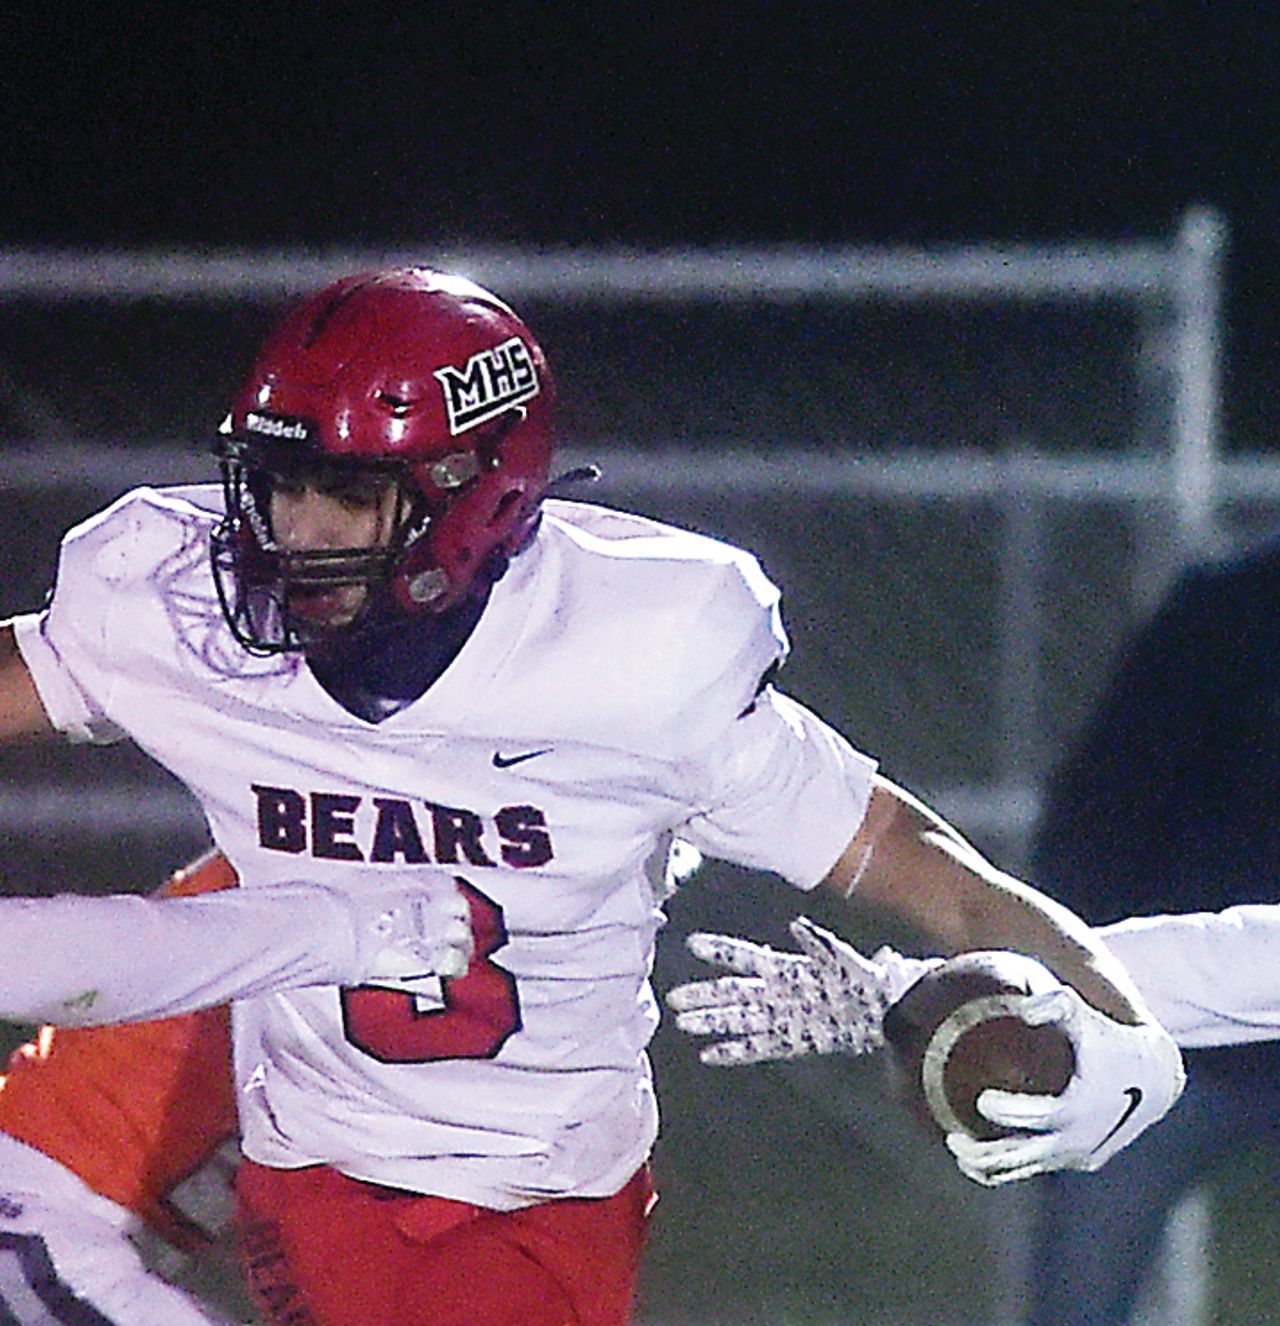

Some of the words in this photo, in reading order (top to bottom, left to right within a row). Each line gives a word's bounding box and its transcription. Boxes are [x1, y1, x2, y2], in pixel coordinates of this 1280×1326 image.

[437, 338, 538, 418] MHS
[250, 782, 556, 870] BEARS
[339, 876, 524, 1065] 3
